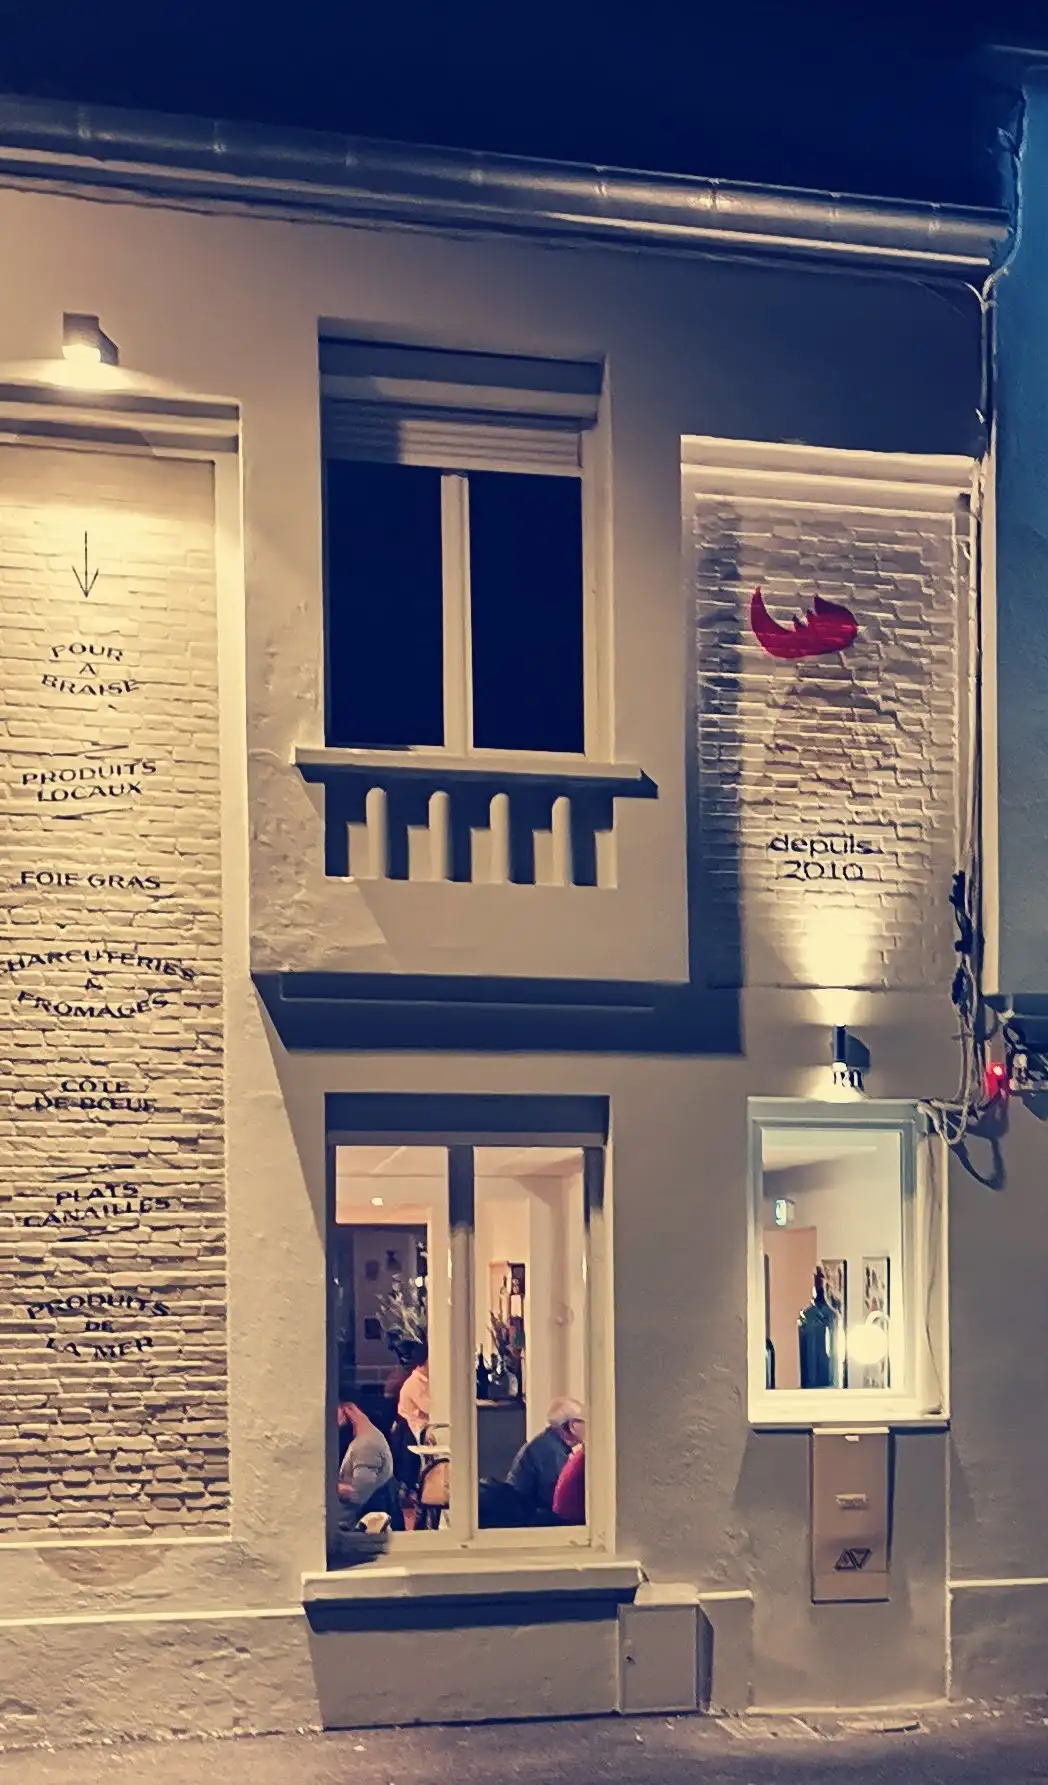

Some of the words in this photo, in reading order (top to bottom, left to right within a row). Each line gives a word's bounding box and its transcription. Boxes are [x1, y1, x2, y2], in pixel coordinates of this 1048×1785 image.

[41, 674, 140, 696] BRAISE
[22, 761, 157, 785] PRODUITS
[37, 781, 143, 802] LOCAUX
[770, 833, 874, 857] depuis
[20, 871, 79, 887] FOIE
[87, 873, 161, 890] GRAS
[782, 860, 864, 881] 2010
[0, 949, 196, 981] HARCUTERIES
[17, 990, 168, 1019] FROMAGES
[56, 1182, 139, 1206] PLATS
[23, 1198, 171, 1228] CANAILLES
[26, 1293, 171, 1320] PRODUITS
[93, 1335, 154, 1361] MER
